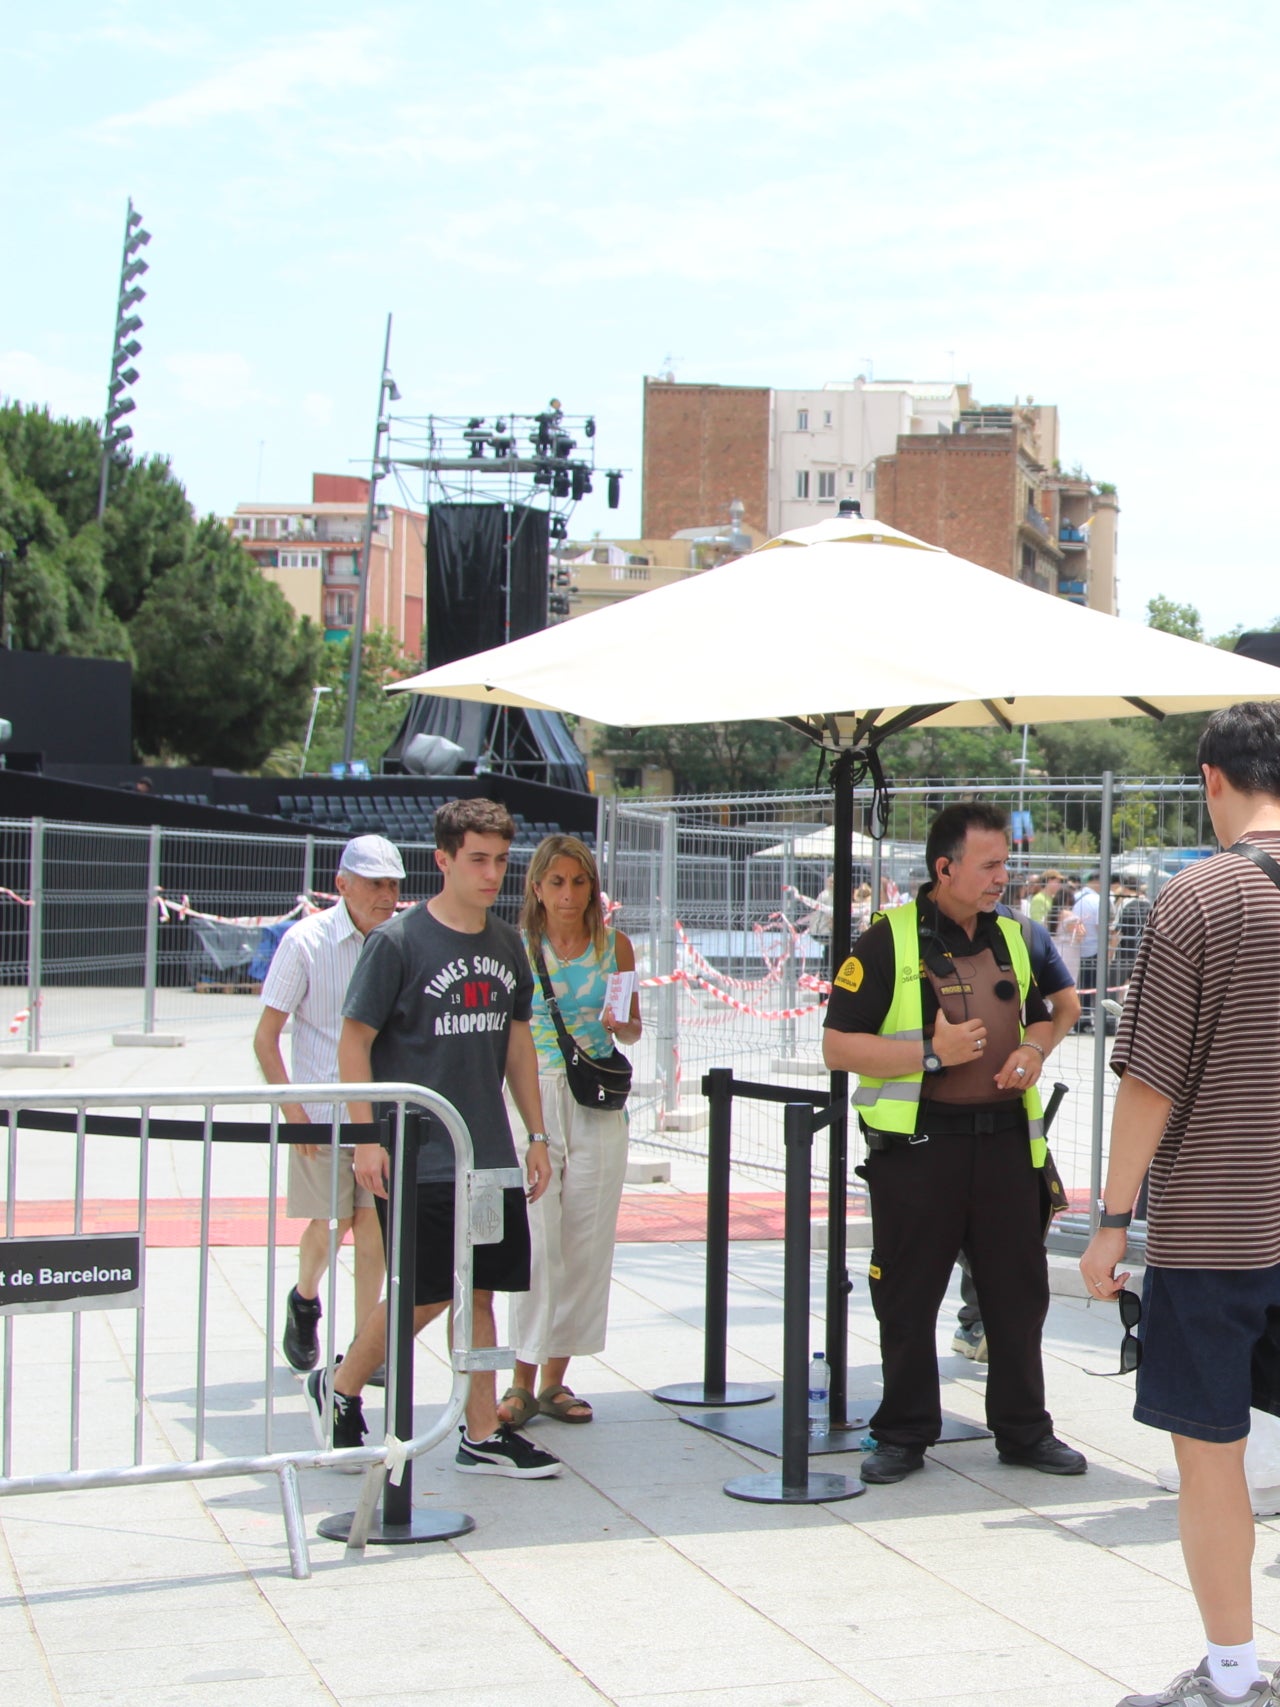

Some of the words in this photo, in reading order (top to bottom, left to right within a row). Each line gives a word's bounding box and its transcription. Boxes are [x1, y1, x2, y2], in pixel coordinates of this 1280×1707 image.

[424, 958, 469, 998] TIMES
[473, 955, 517, 994] SQUARE
[464, 982, 490, 1008] NY
[10, 1269, 33, 1286] de
[39, 1266, 132, 1285] Barcelona
